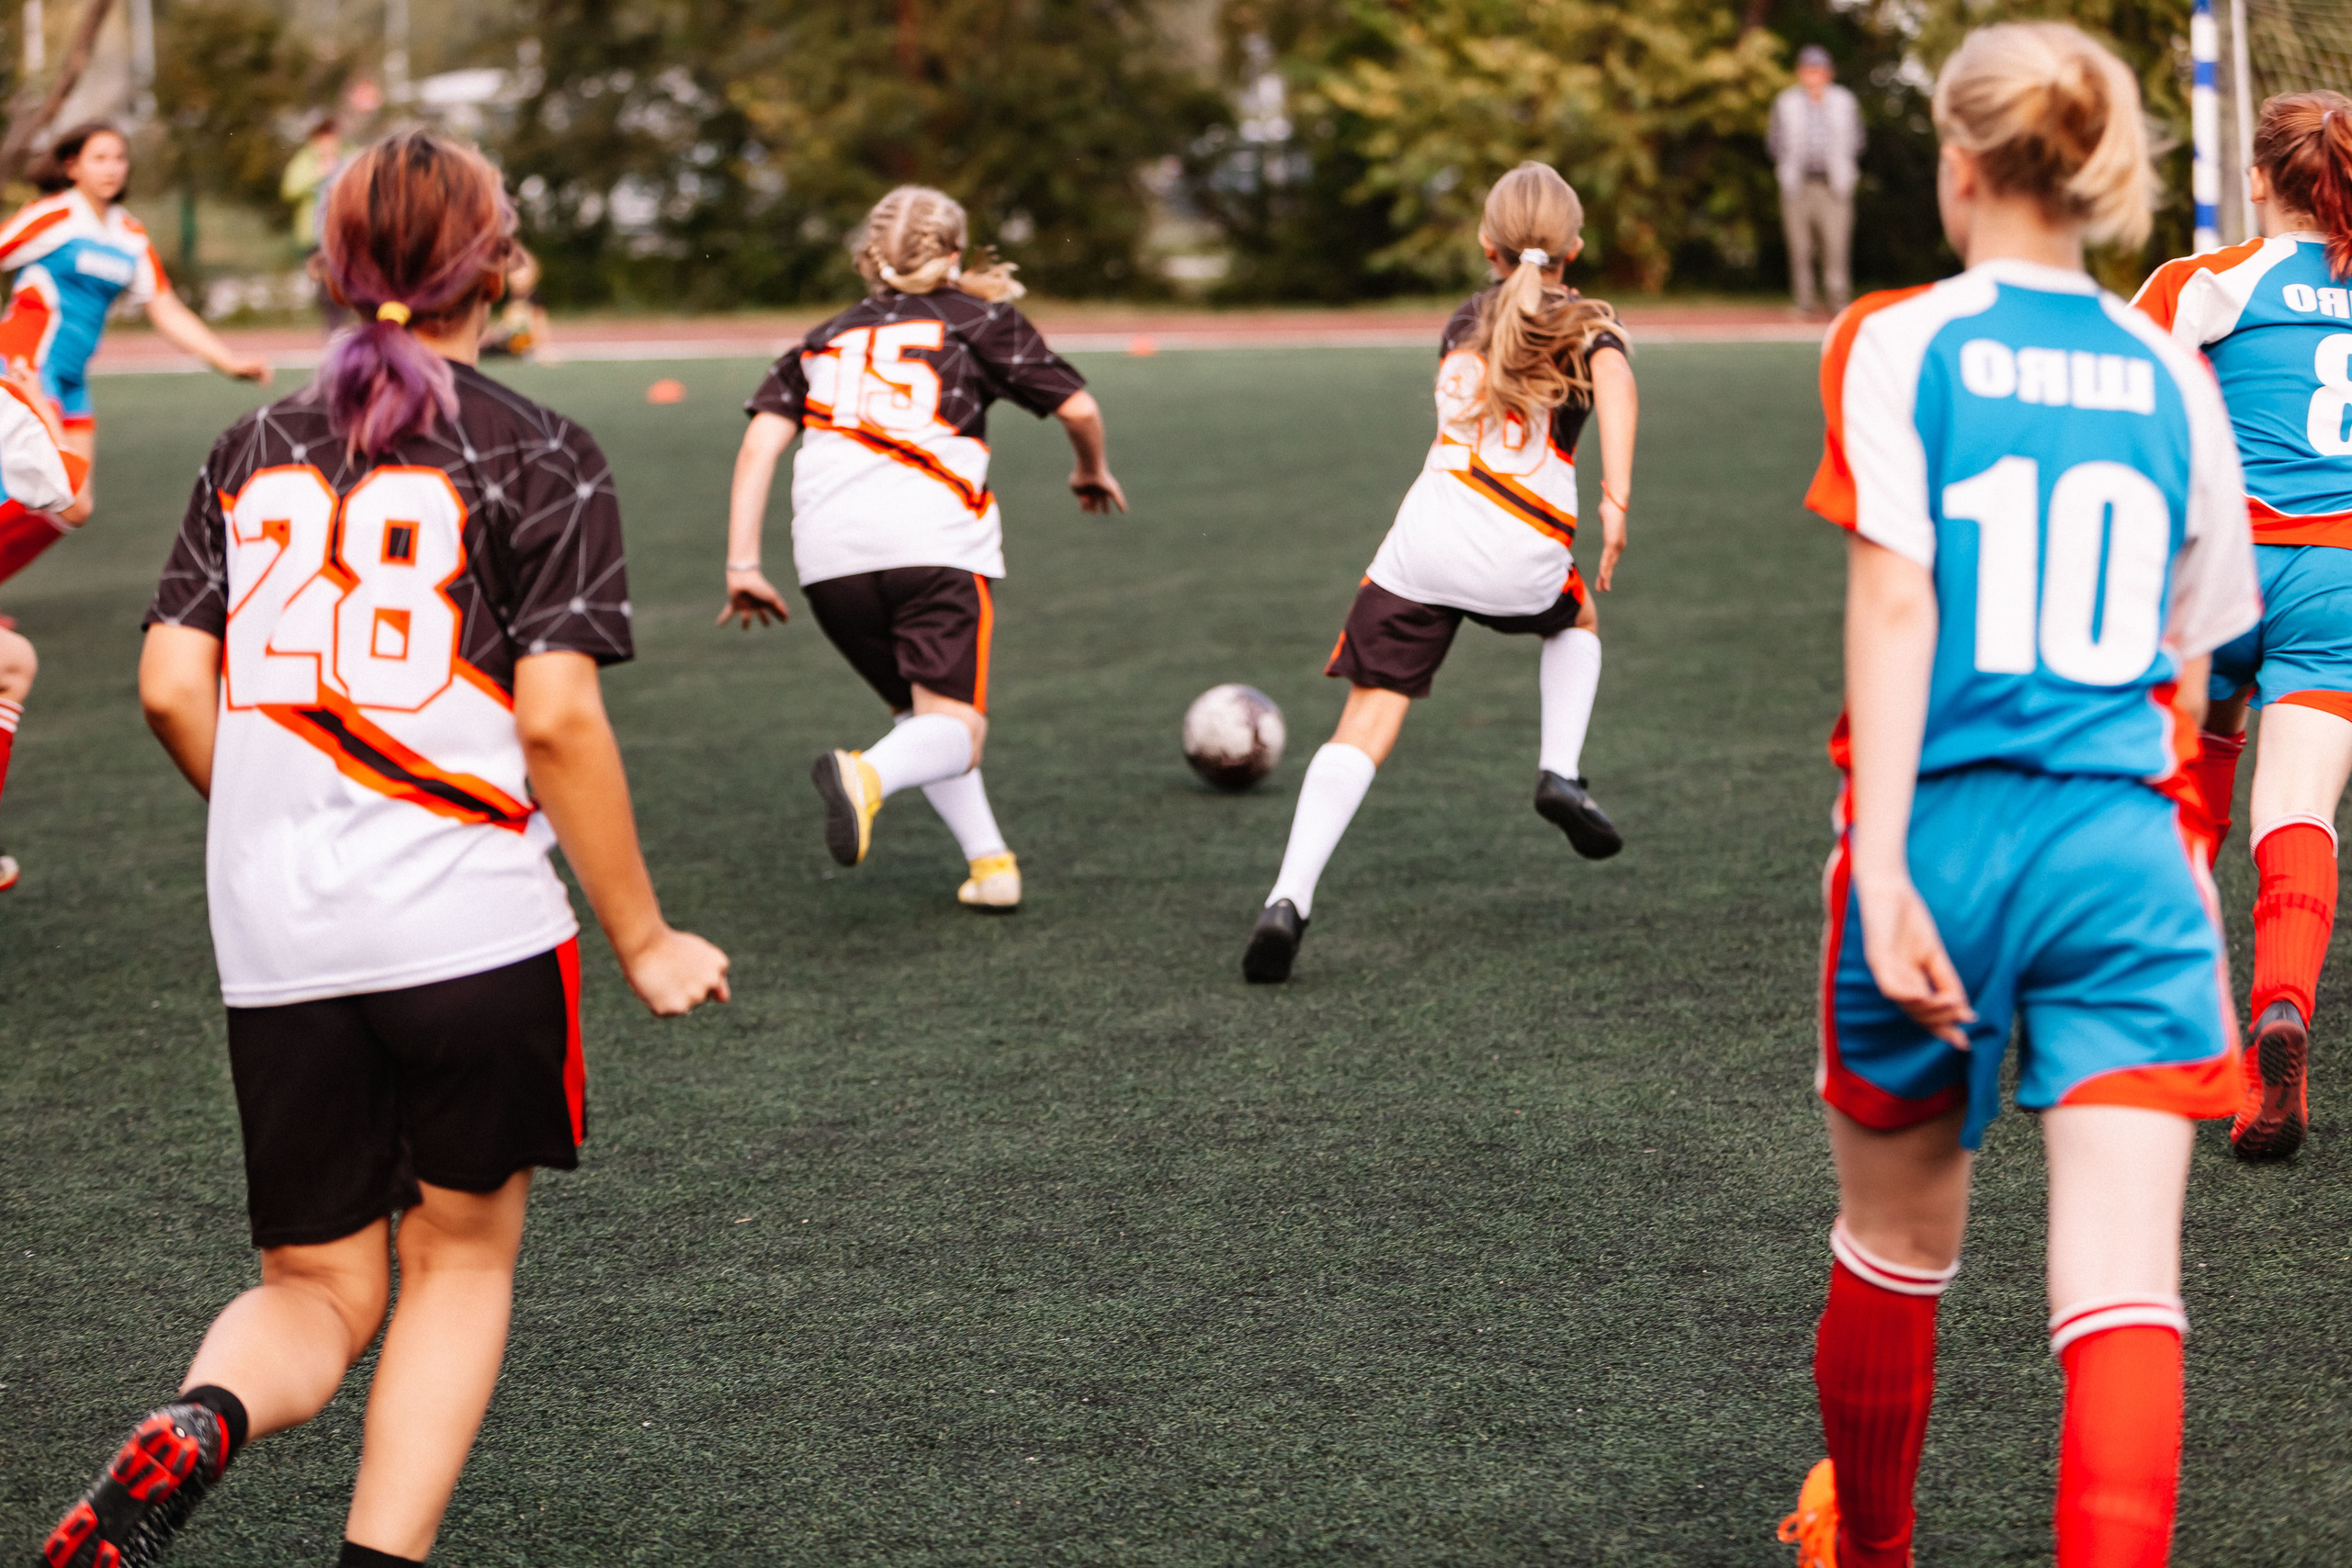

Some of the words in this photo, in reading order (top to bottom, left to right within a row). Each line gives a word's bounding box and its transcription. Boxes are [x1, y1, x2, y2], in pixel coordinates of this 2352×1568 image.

[2282, 283, 2352, 319] ОЯ
[826, 320, 944, 431] 15
[1960, 338, 2155, 415] ОЯШ
[226, 465, 468, 712] 28
[1942, 456, 2170, 686] 10
